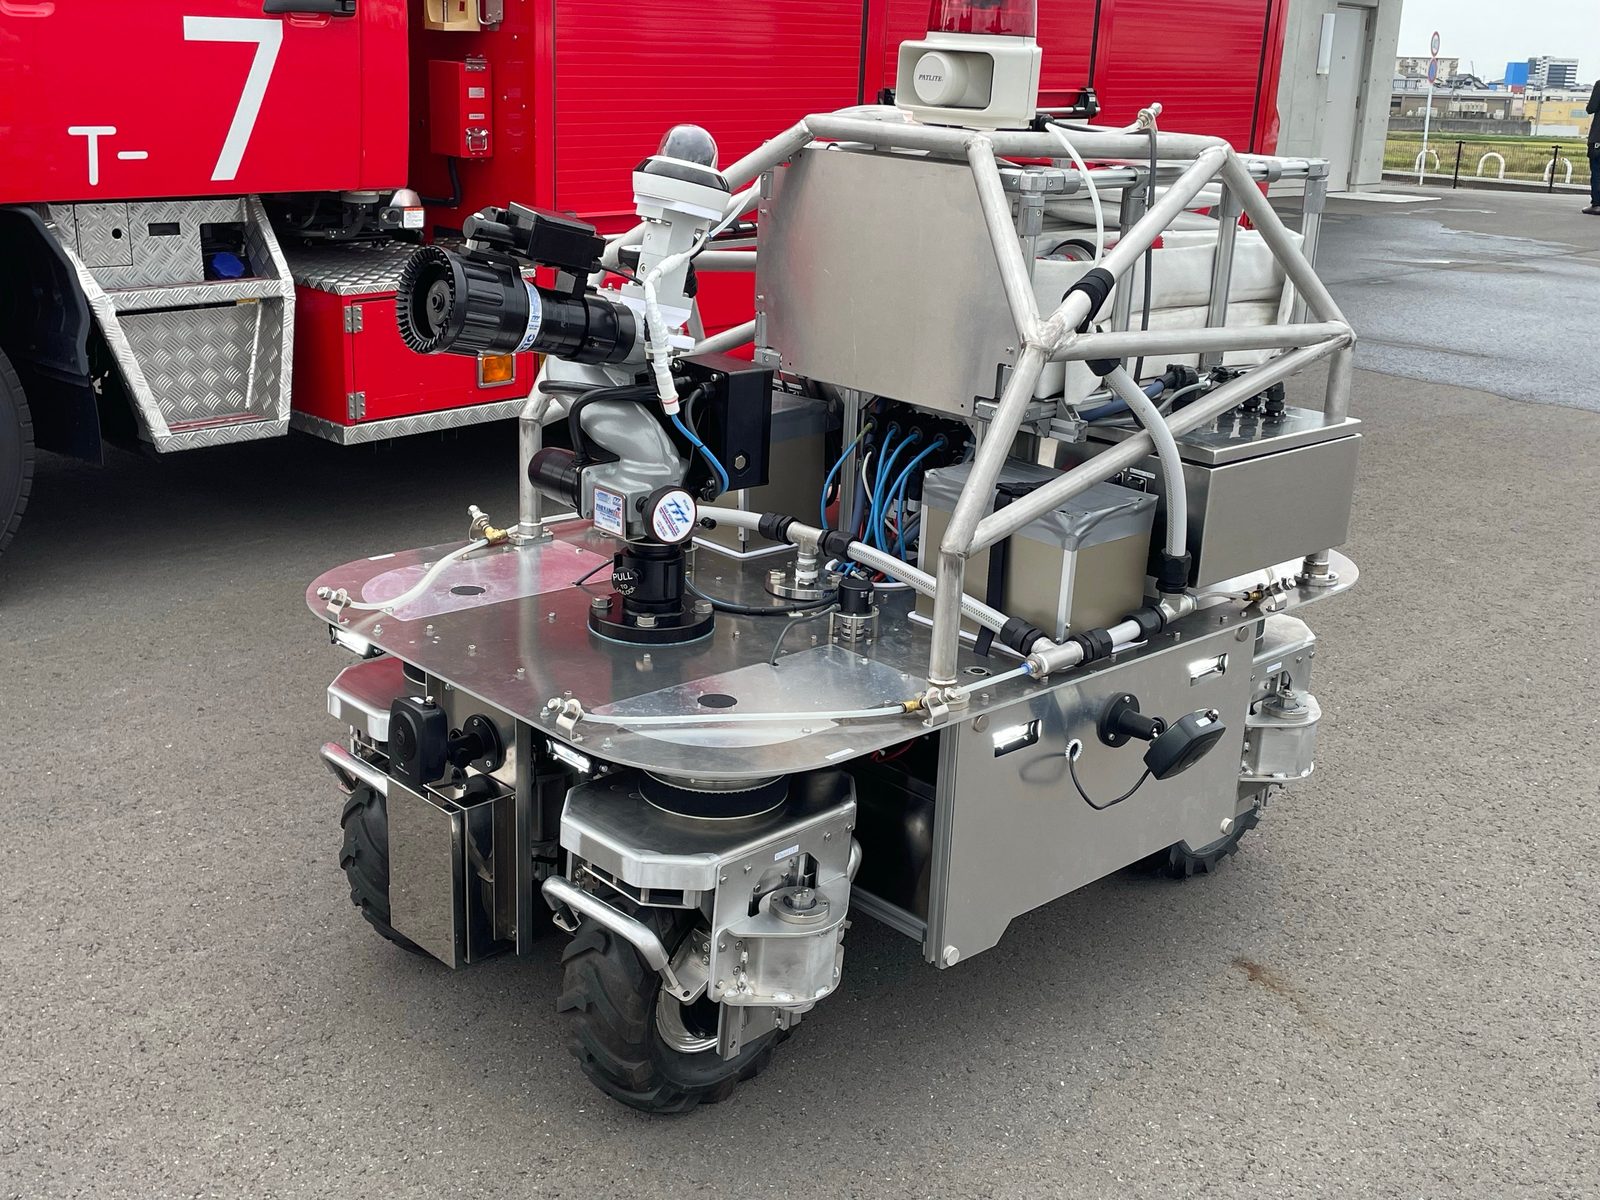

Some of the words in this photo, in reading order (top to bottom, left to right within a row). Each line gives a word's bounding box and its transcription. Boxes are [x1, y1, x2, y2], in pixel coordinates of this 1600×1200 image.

[918, 74, 943, 82] PATLITE
[183, 15, 284, 181] 7
[612, 571, 633, 581] PULL
